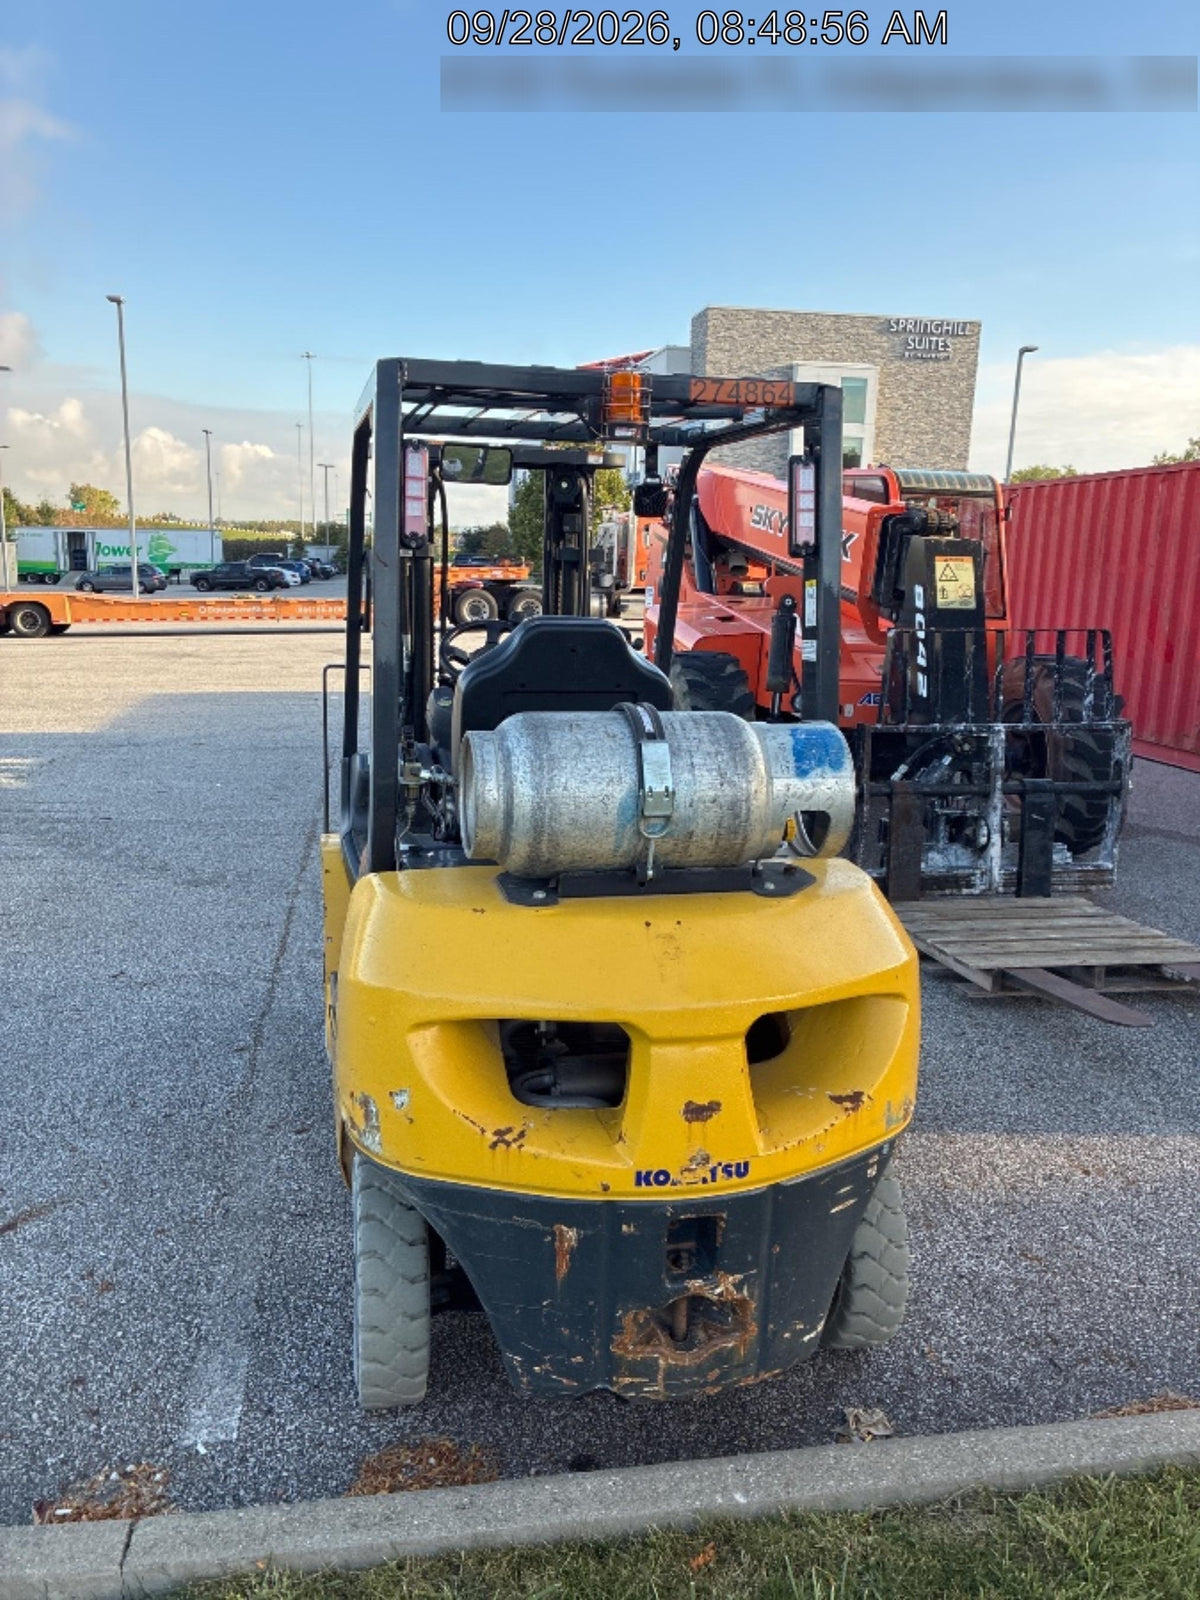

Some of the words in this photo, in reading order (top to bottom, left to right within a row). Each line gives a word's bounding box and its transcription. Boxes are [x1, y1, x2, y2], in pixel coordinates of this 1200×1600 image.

[889, 318, 974, 336] SPRINGHILL
[906, 335, 953, 352] SUITES
[691, 378, 793, 408] 274864
